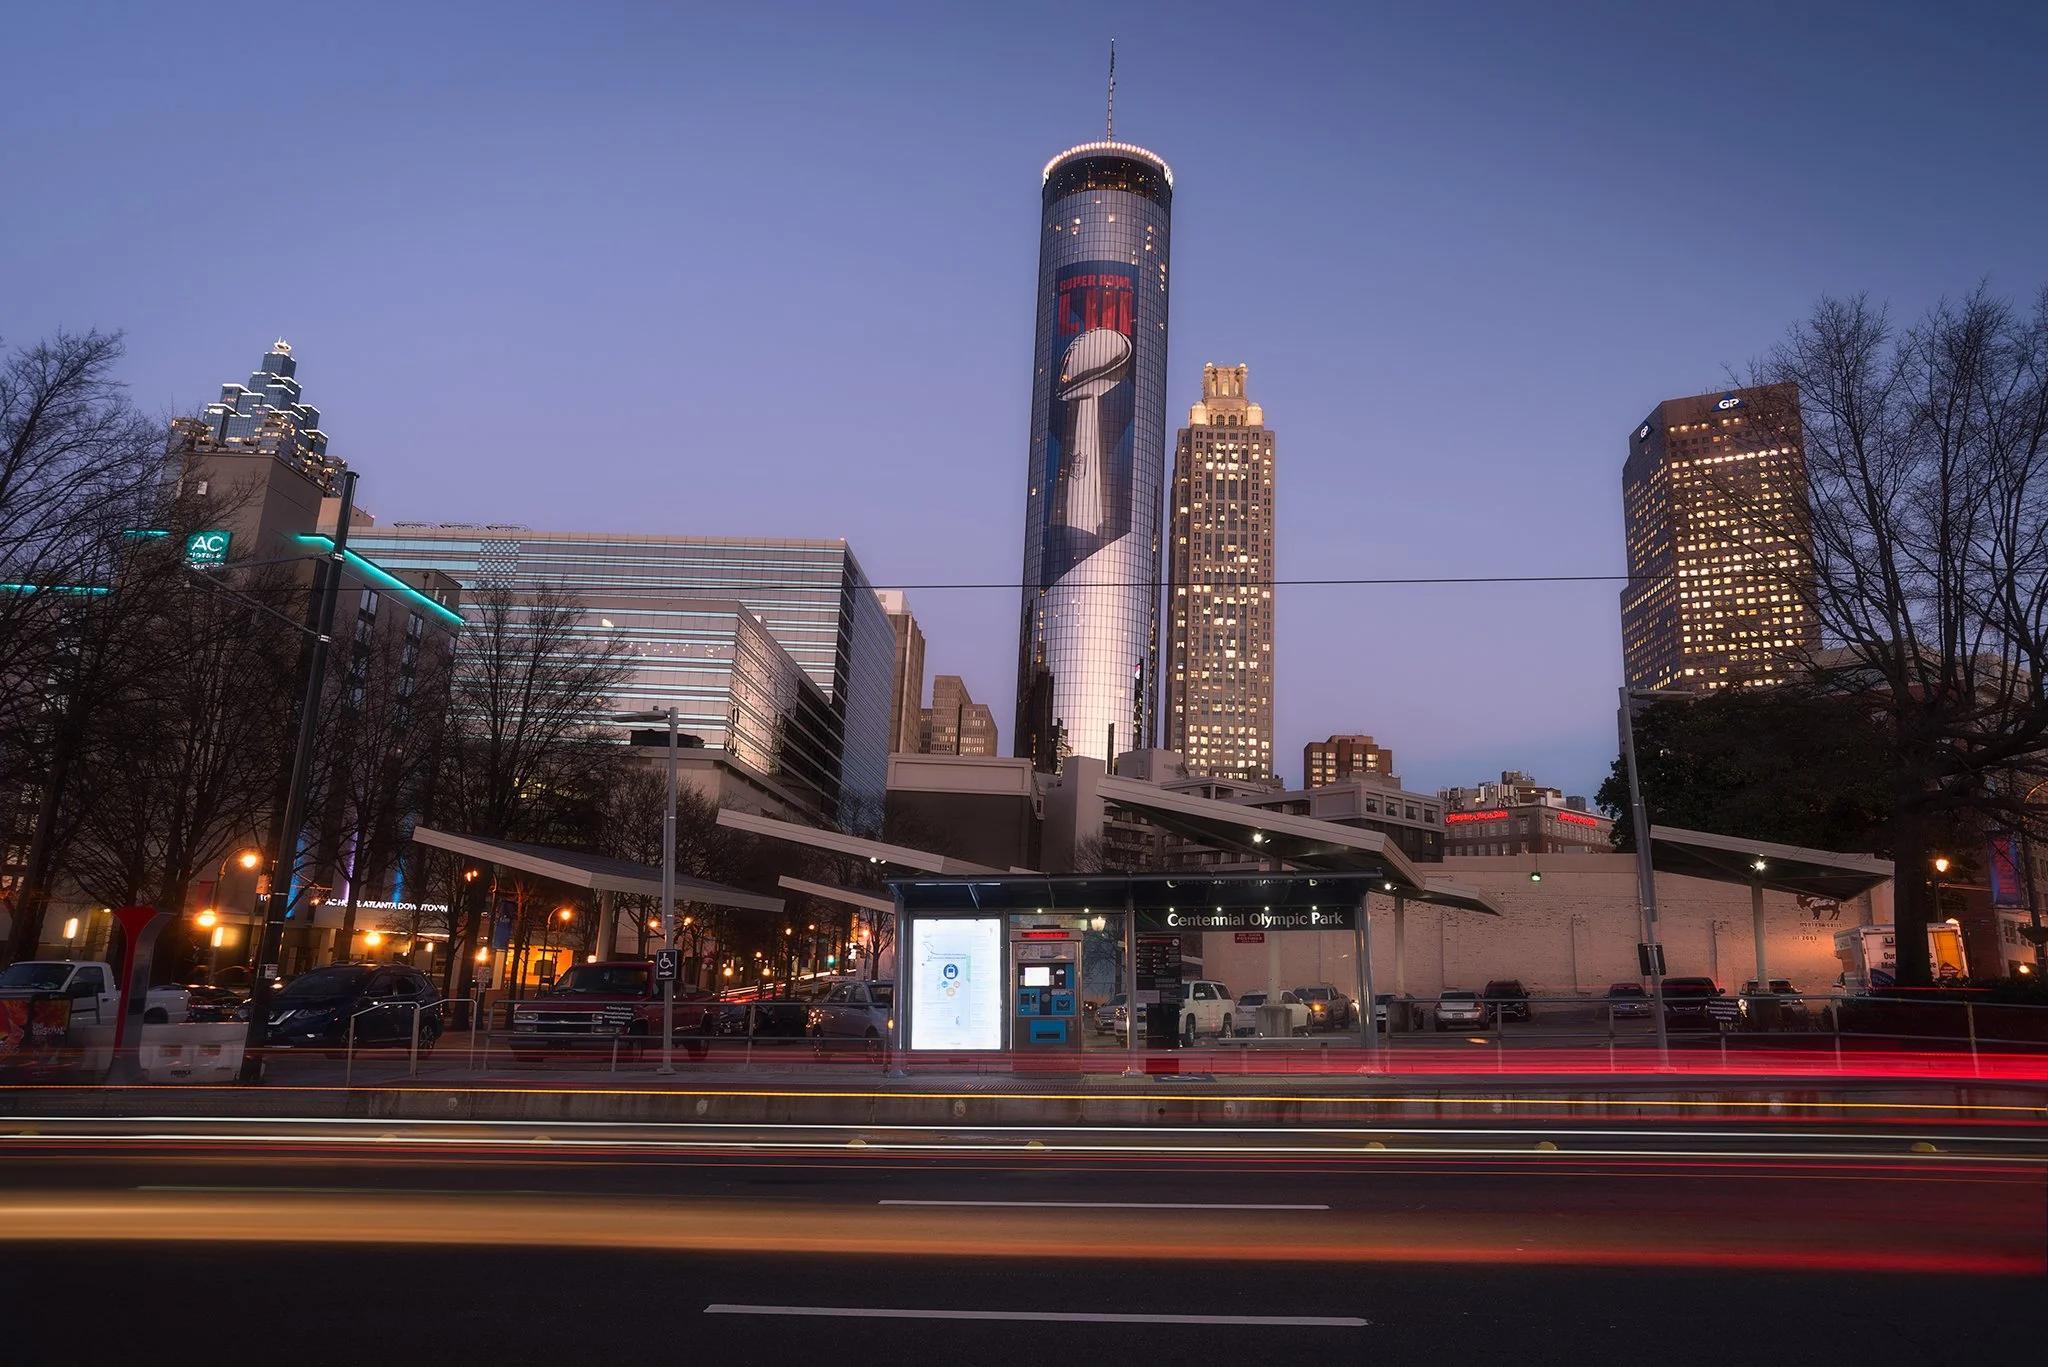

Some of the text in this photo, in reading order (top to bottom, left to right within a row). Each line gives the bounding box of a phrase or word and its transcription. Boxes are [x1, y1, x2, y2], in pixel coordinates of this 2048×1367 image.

[1059, 273, 1133, 292] SUPER BOWL
[1718, 398, 1740, 409] GP
[1640, 425, 1649, 438] GP
[191, 535, 224, 552] AC
[324, 898, 337, 906] AC
[362, 900, 397, 910] ATLANTA
[1805, 897, 1836, 909] Ted's
[1166, 911, 1344, 929] Centennial Olympic Park
[1883, 952, 1896, 960] Our
